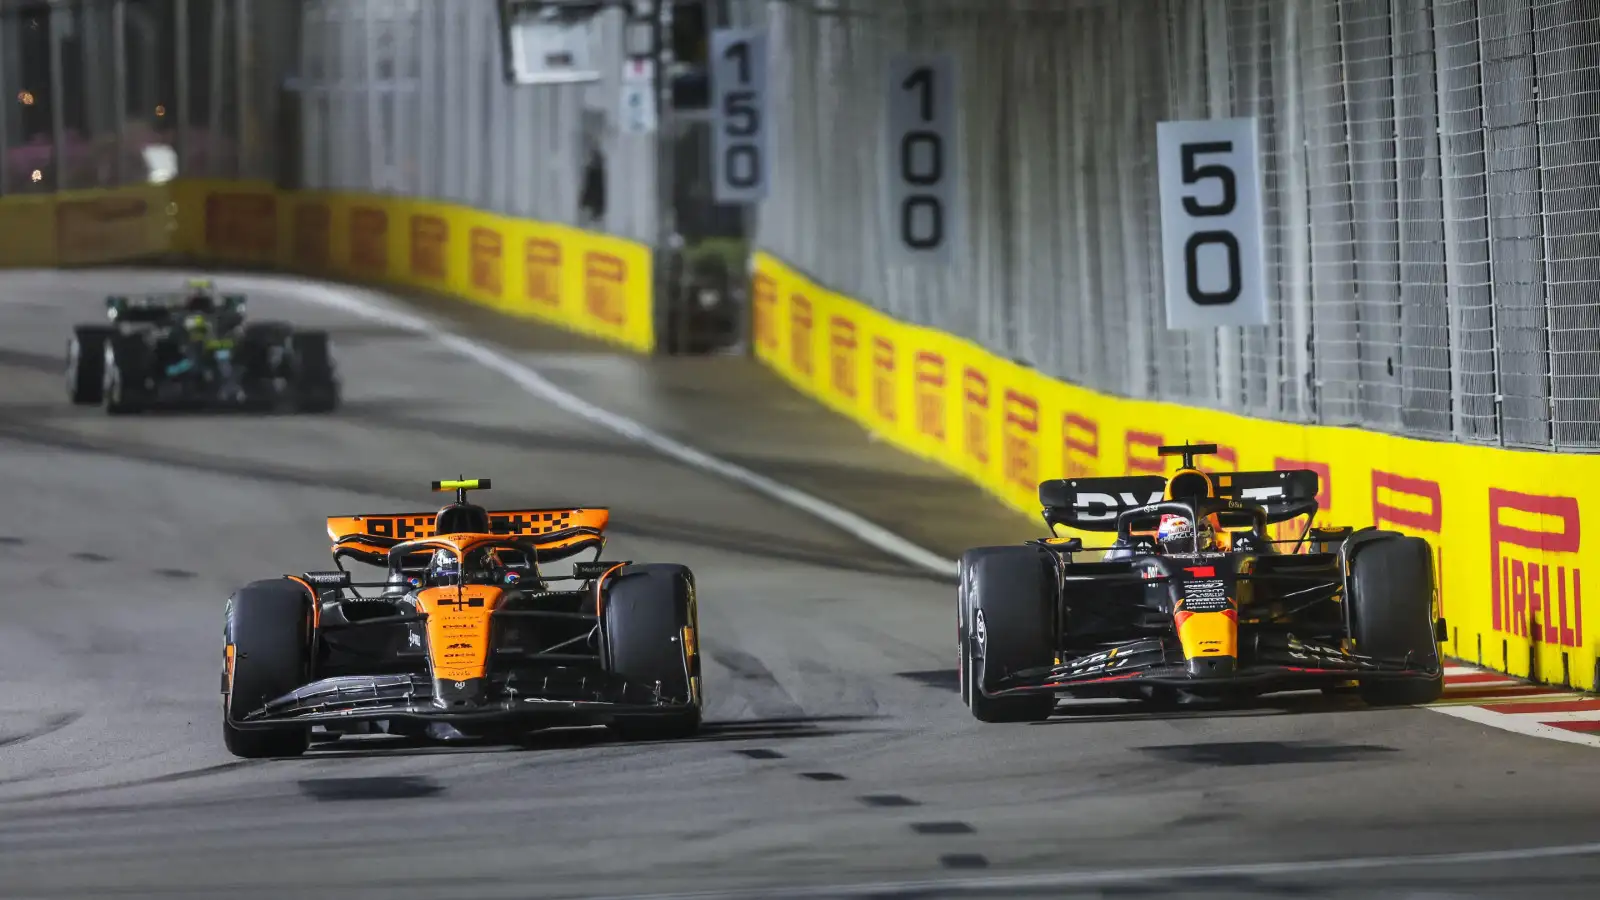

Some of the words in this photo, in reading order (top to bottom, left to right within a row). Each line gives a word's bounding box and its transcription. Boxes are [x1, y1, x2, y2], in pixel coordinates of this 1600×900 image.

[724, 40, 759, 188] 150
[902, 65, 943, 249] 100
[1180, 141, 1243, 306] 50
[1489, 487, 1583, 648] PIRELLI
